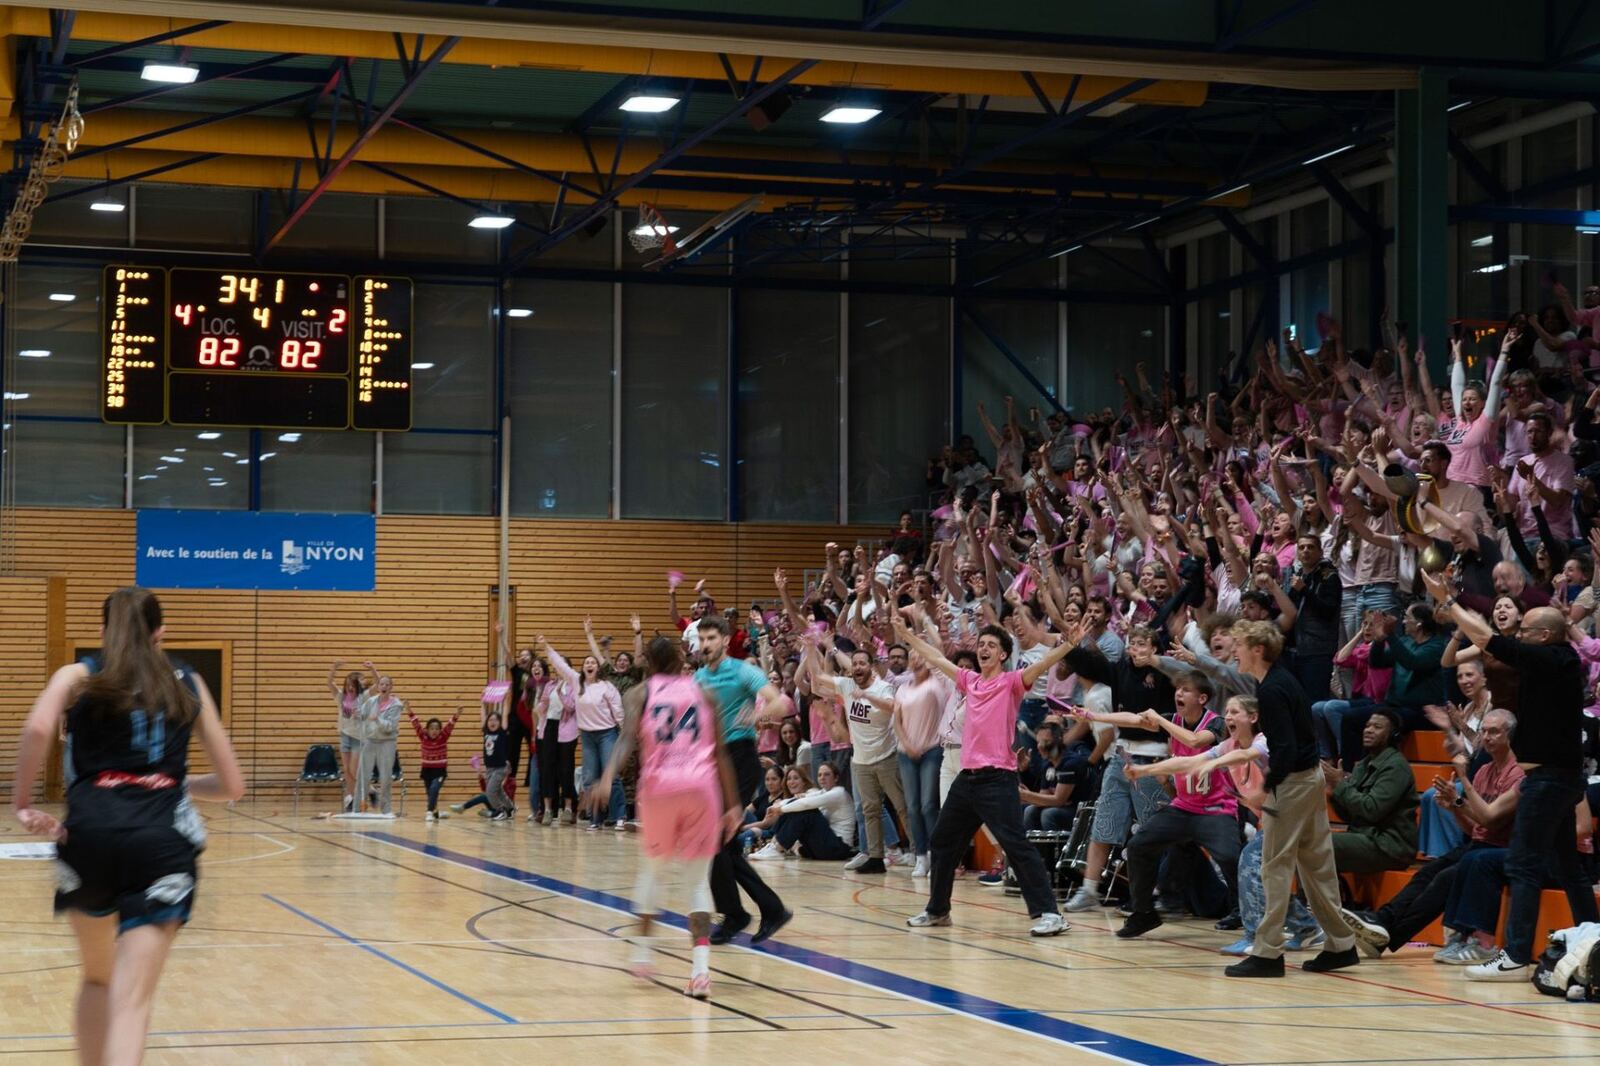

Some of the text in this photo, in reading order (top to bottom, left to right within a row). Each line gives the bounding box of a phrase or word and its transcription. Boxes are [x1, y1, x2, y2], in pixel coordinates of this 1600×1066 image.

[119, 282, 126, 293] 1
[116, 294, 126, 306] 3
[364, 291, 373, 303] 2
[116, 307, 126, 319] 5
[175, 304, 192, 326] 4
[364, 303, 373, 316] 3
[253, 307, 270, 329] 4
[329, 309, 346, 333] 2
[364, 317, 373, 328] 4
[111, 319, 126, 331] 11
[201, 318, 239, 336] LOC.
[281, 320, 327, 340] VISIT.
[111, 332, 125, 344] 12
[111, 345, 125, 357] 19
[199, 337, 240, 366] 82
[281, 340, 321, 369] 82
[107, 357, 125, 370] 22
[360, 353, 373, 365] 11
[107, 370, 125, 382] 25
[360, 366, 373, 377] 14
[107, 382, 125, 395] 34
[359, 378, 372, 390] 15
[359, 390, 372, 403] 16
[146, 546, 273, 560] Avec le soutien de la
[306, 546, 364, 561] NYON
[850, 701, 872, 718] NBF
[652, 703, 701, 744] 34
[1185, 771, 1210, 795] 14
